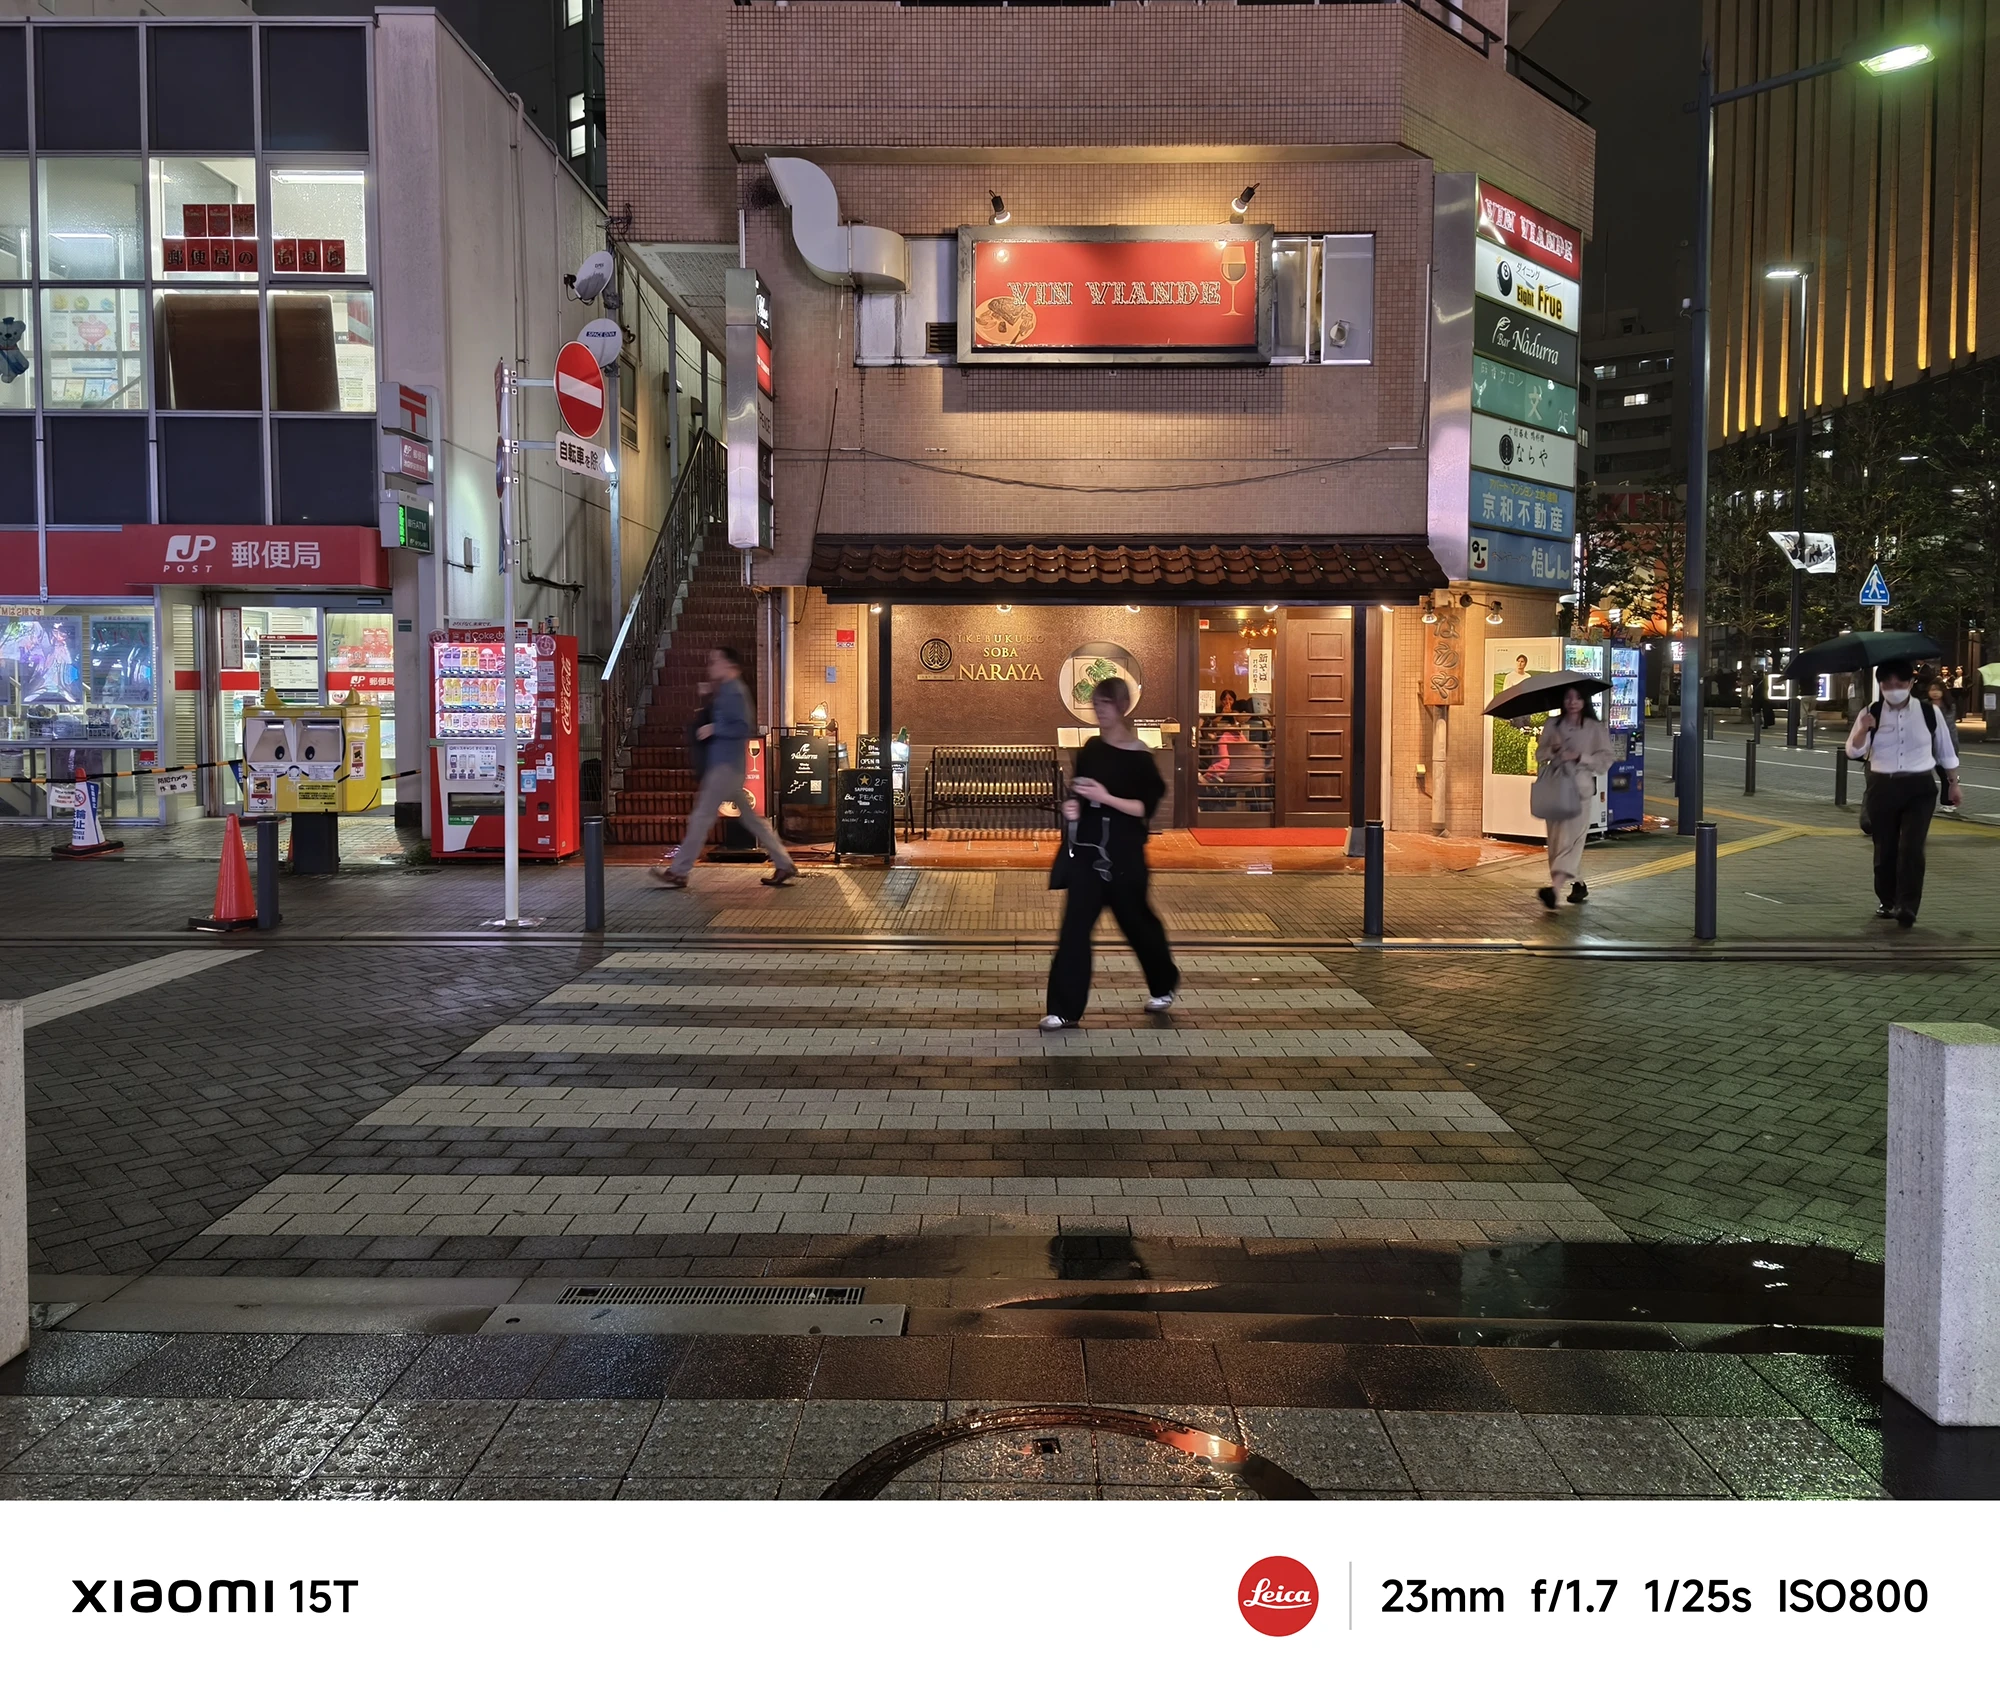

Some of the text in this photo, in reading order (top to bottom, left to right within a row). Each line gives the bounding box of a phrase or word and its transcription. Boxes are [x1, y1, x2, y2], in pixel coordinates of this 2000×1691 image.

[1485, 198, 1573, 264] VIN VIANDE
[167, 249, 254, 267] 郵便局の
[1502, 264, 1509, 279] 8
[1516, 262, 1541, 281] ダイニング
[1007, 281, 1221, 306] VIN VIANDE
[1516, 283, 1563, 320] Eight Frue
[1497, 333, 1511, 348] Bar
[1517, 443, 1548, 467] ならや
[1482, 492, 1563, 533] 京和不動産
[231, 541, 321, 569] 郵便局
[1531, 546, 1570, 580] 福しん
[163, 565, 213, 573] POST
[0, 606, 42, 616] Mは2階です
[472, 631, 495, 640] Coke
[958, 634, 1046, 644] IKEBUKURO
[983, 647, 1019, 658] SOBA
[958, 663, 1044, 681] NARAYA
[874, 778, 888, 787] 2F
